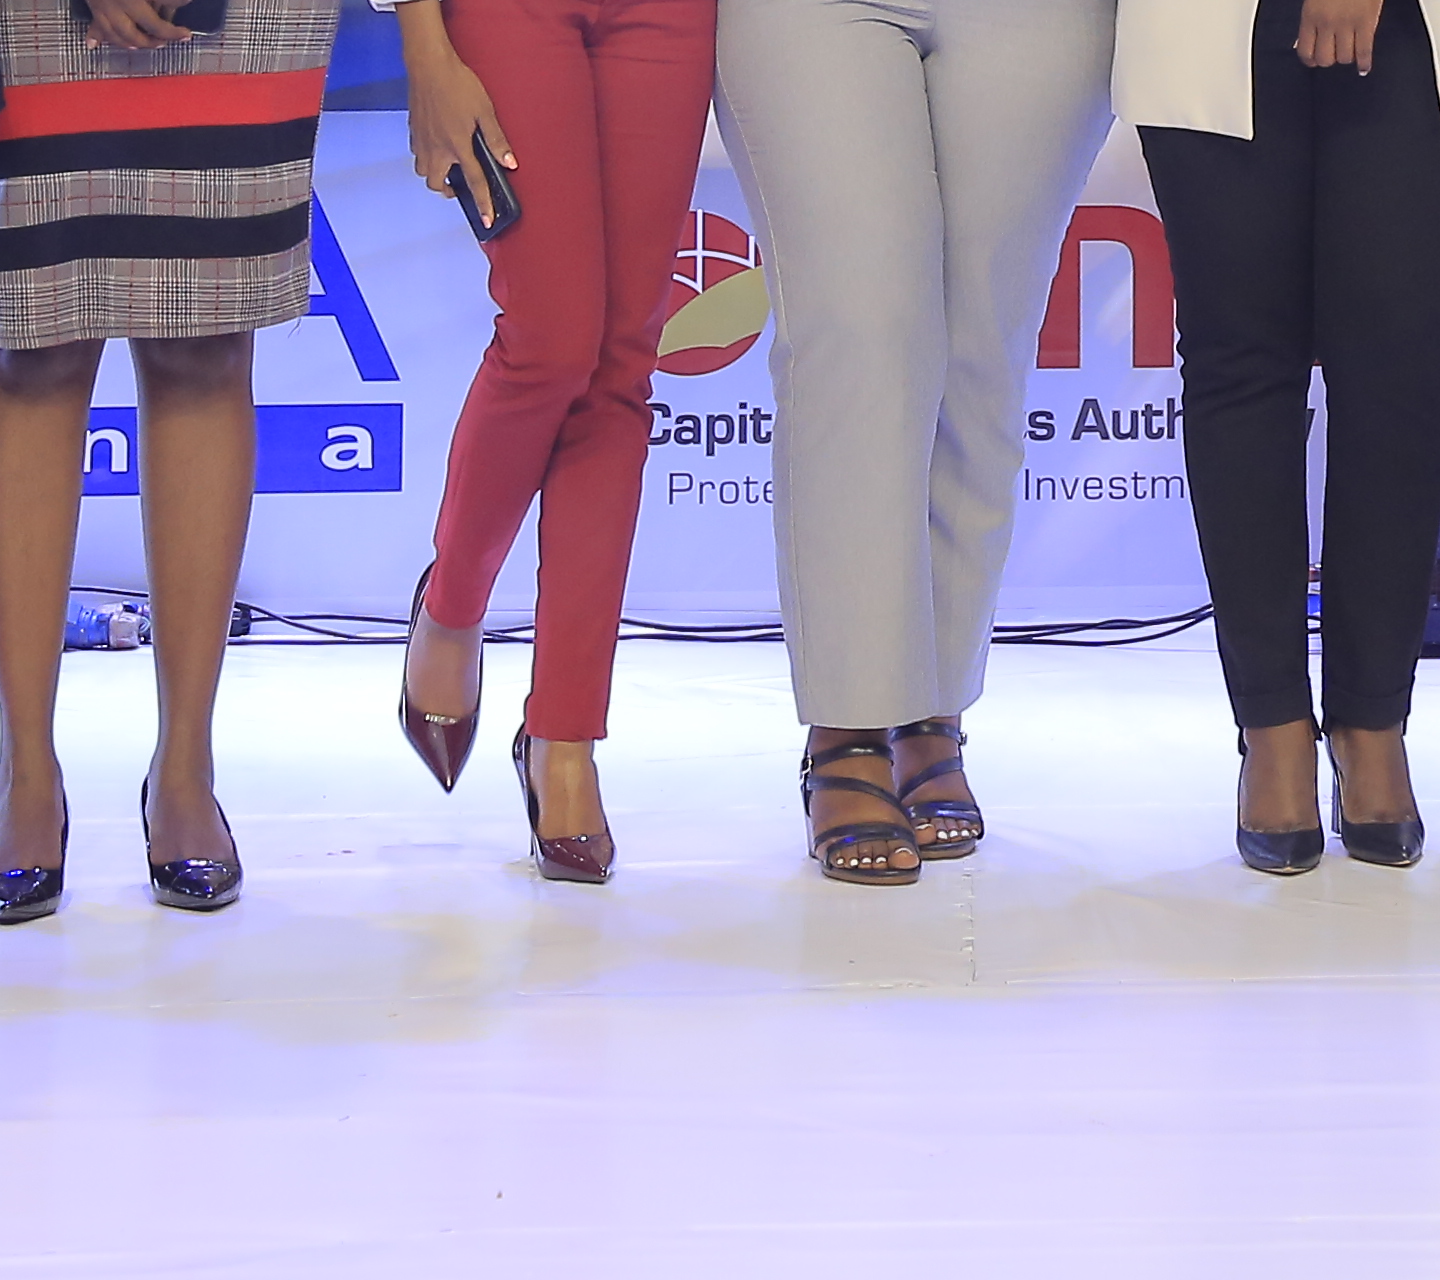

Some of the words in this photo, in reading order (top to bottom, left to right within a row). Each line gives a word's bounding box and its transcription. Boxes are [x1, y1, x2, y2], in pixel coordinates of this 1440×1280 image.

[648, 402, 773, 457] Capit
[669, 472, 773, 505] Prote
[1024, 468, 1185, 501] Investm
